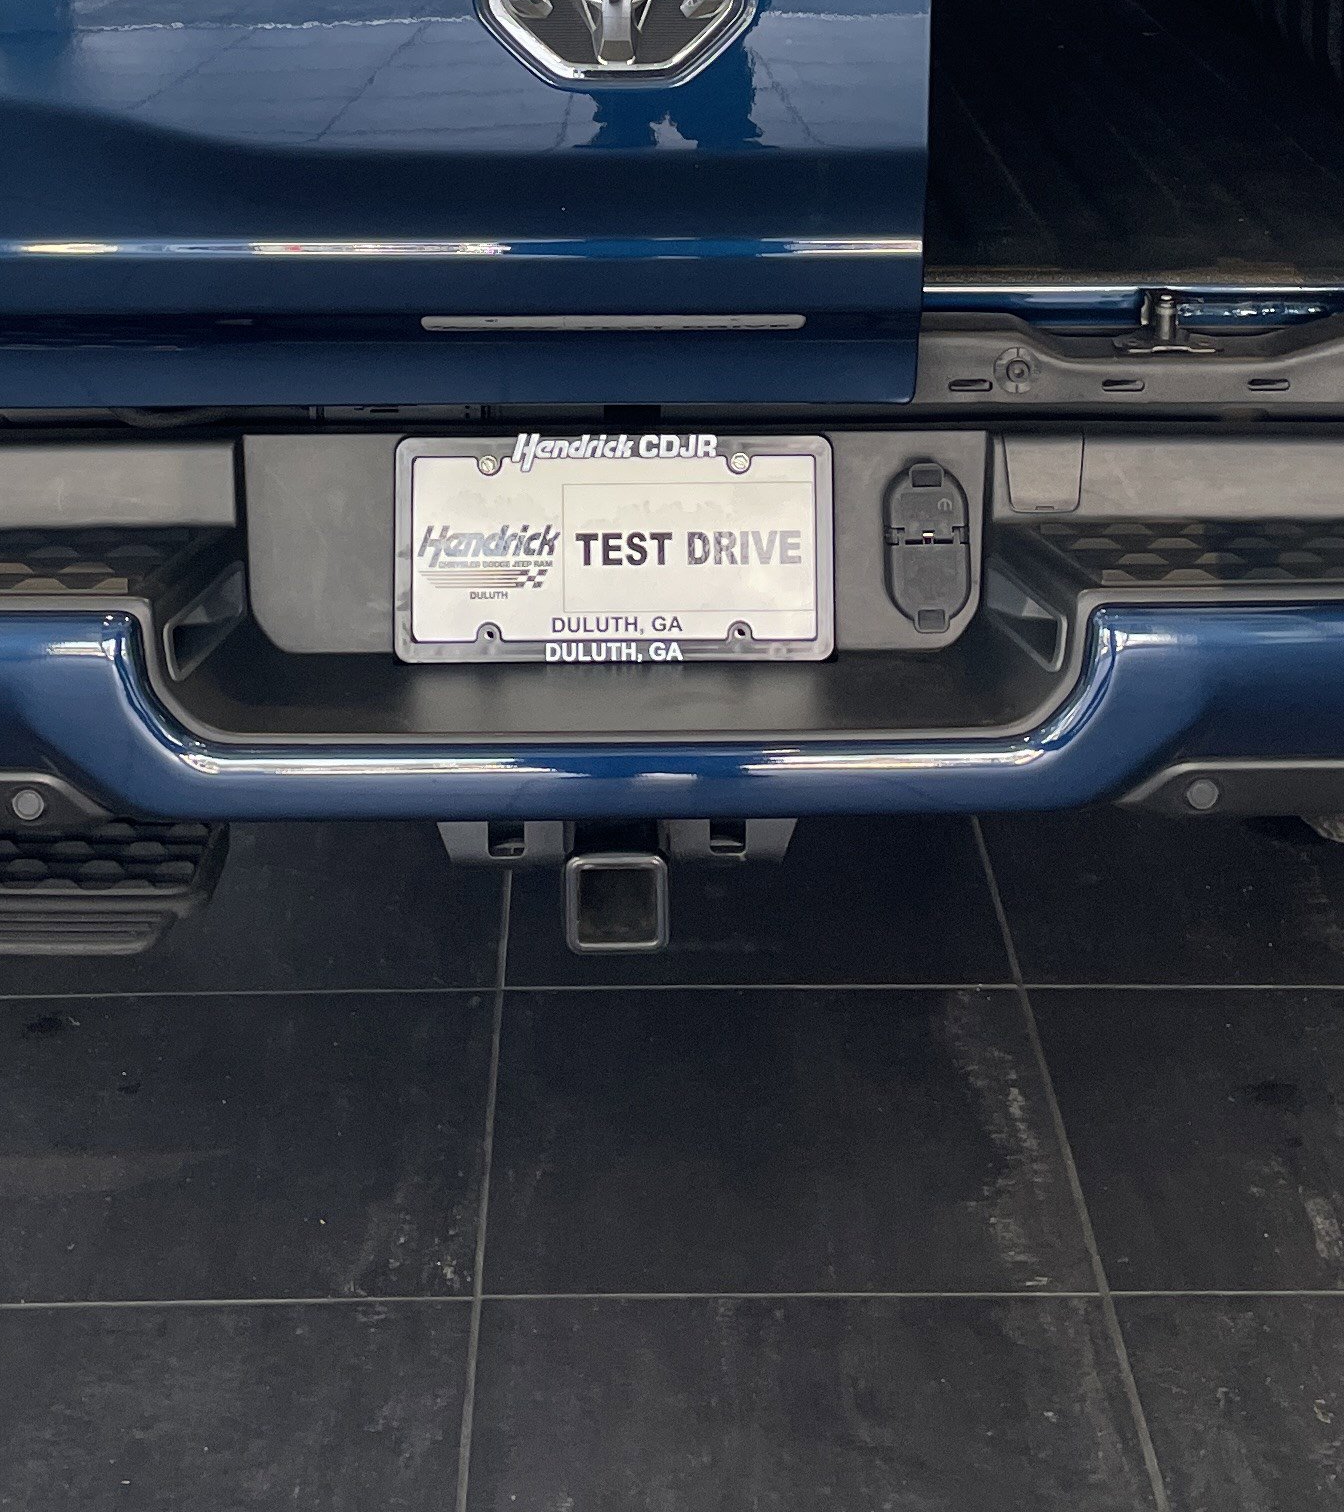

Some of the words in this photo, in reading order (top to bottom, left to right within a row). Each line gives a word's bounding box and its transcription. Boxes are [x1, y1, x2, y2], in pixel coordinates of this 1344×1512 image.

[513, 434, 635, 472] Hendrick
[638, 434, 719, 458] CDJR
[417, 524, 560, 568] Hendrick
[575, 532, 672, 566] TEST
[686, 530, 802, 566] DRIVE
[470, 591, 508, 600] DULUTH
[551, 616, 645, 635] DULUTH,
[652, 616, 683, 633] GA
[545, 642, 643, 663] DULUTH,
[649, 642, 684, 661] GA
